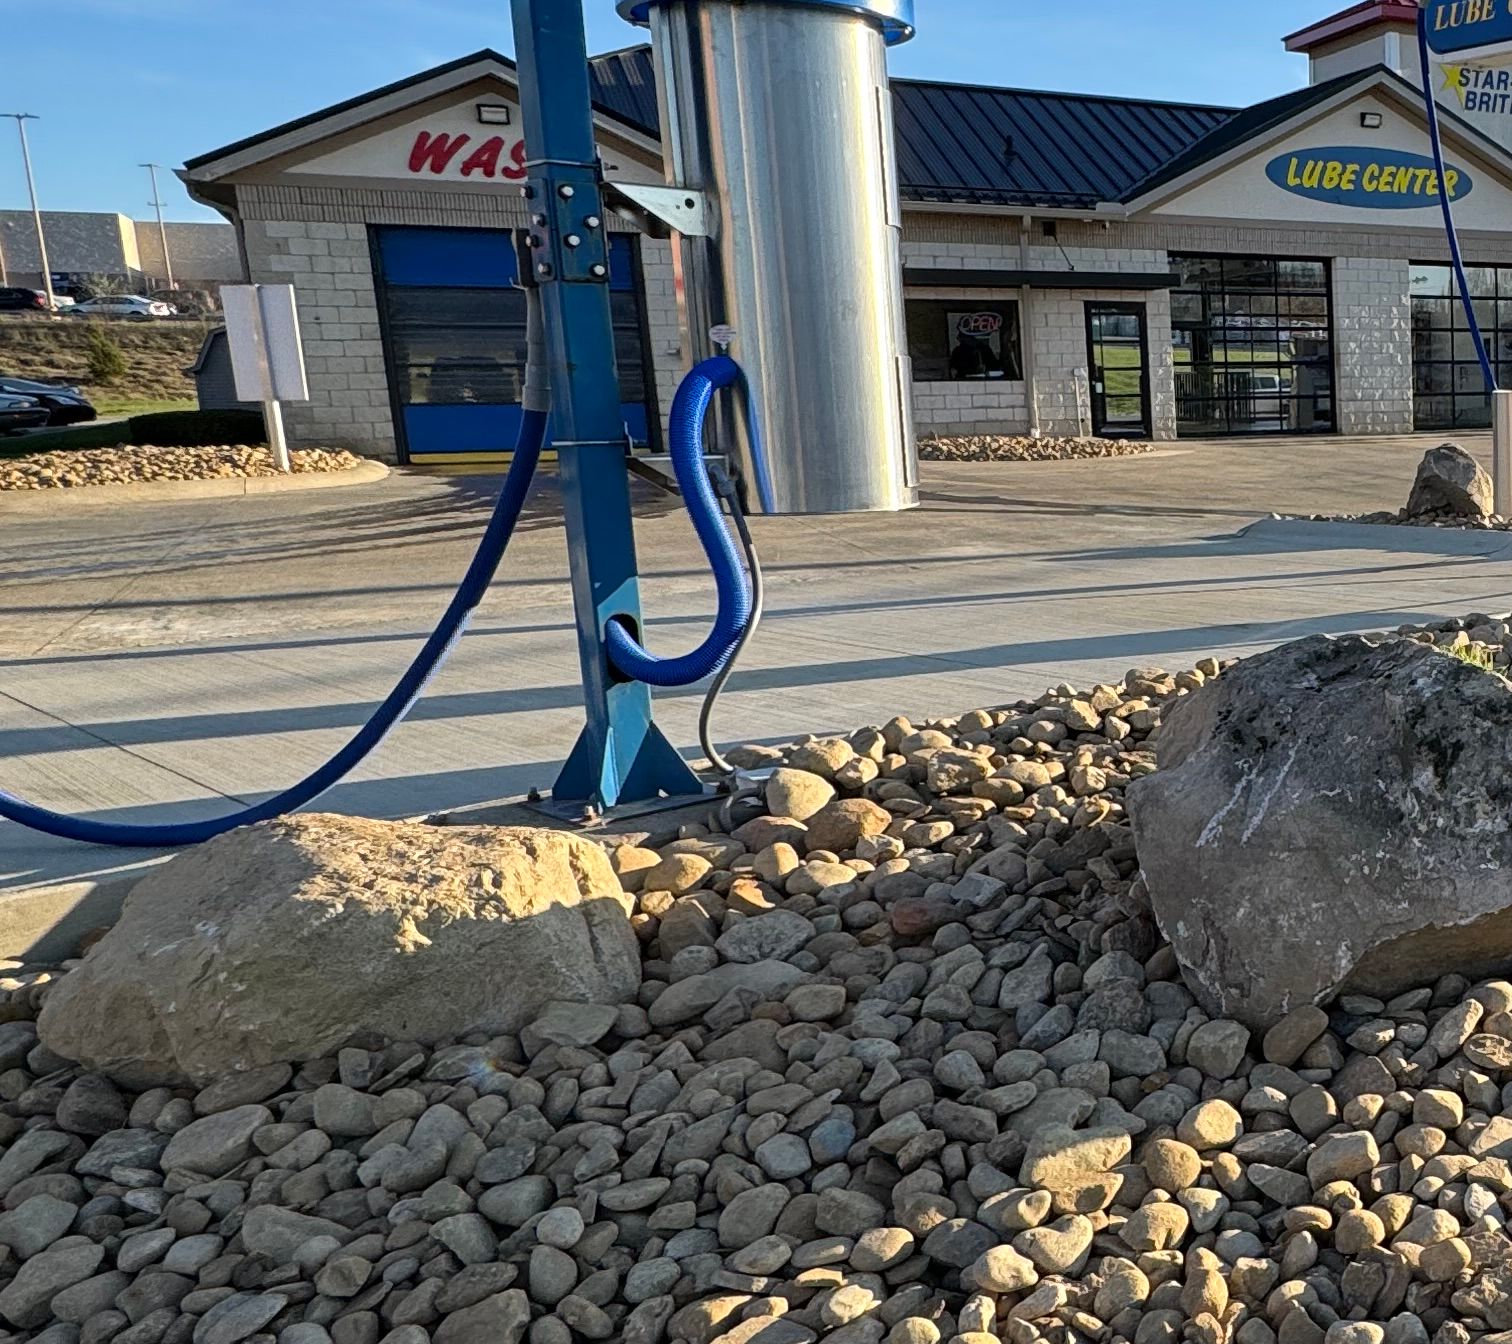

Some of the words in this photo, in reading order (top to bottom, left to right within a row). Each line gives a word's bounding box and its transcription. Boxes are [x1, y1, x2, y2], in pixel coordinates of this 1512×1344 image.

[408, 131, 527, 179] WAS
[1286, 157, 1360, 191] LUBE
[1362, 162, 1459, 197] CENTER
[961, 315, 999, 331] OPEN
